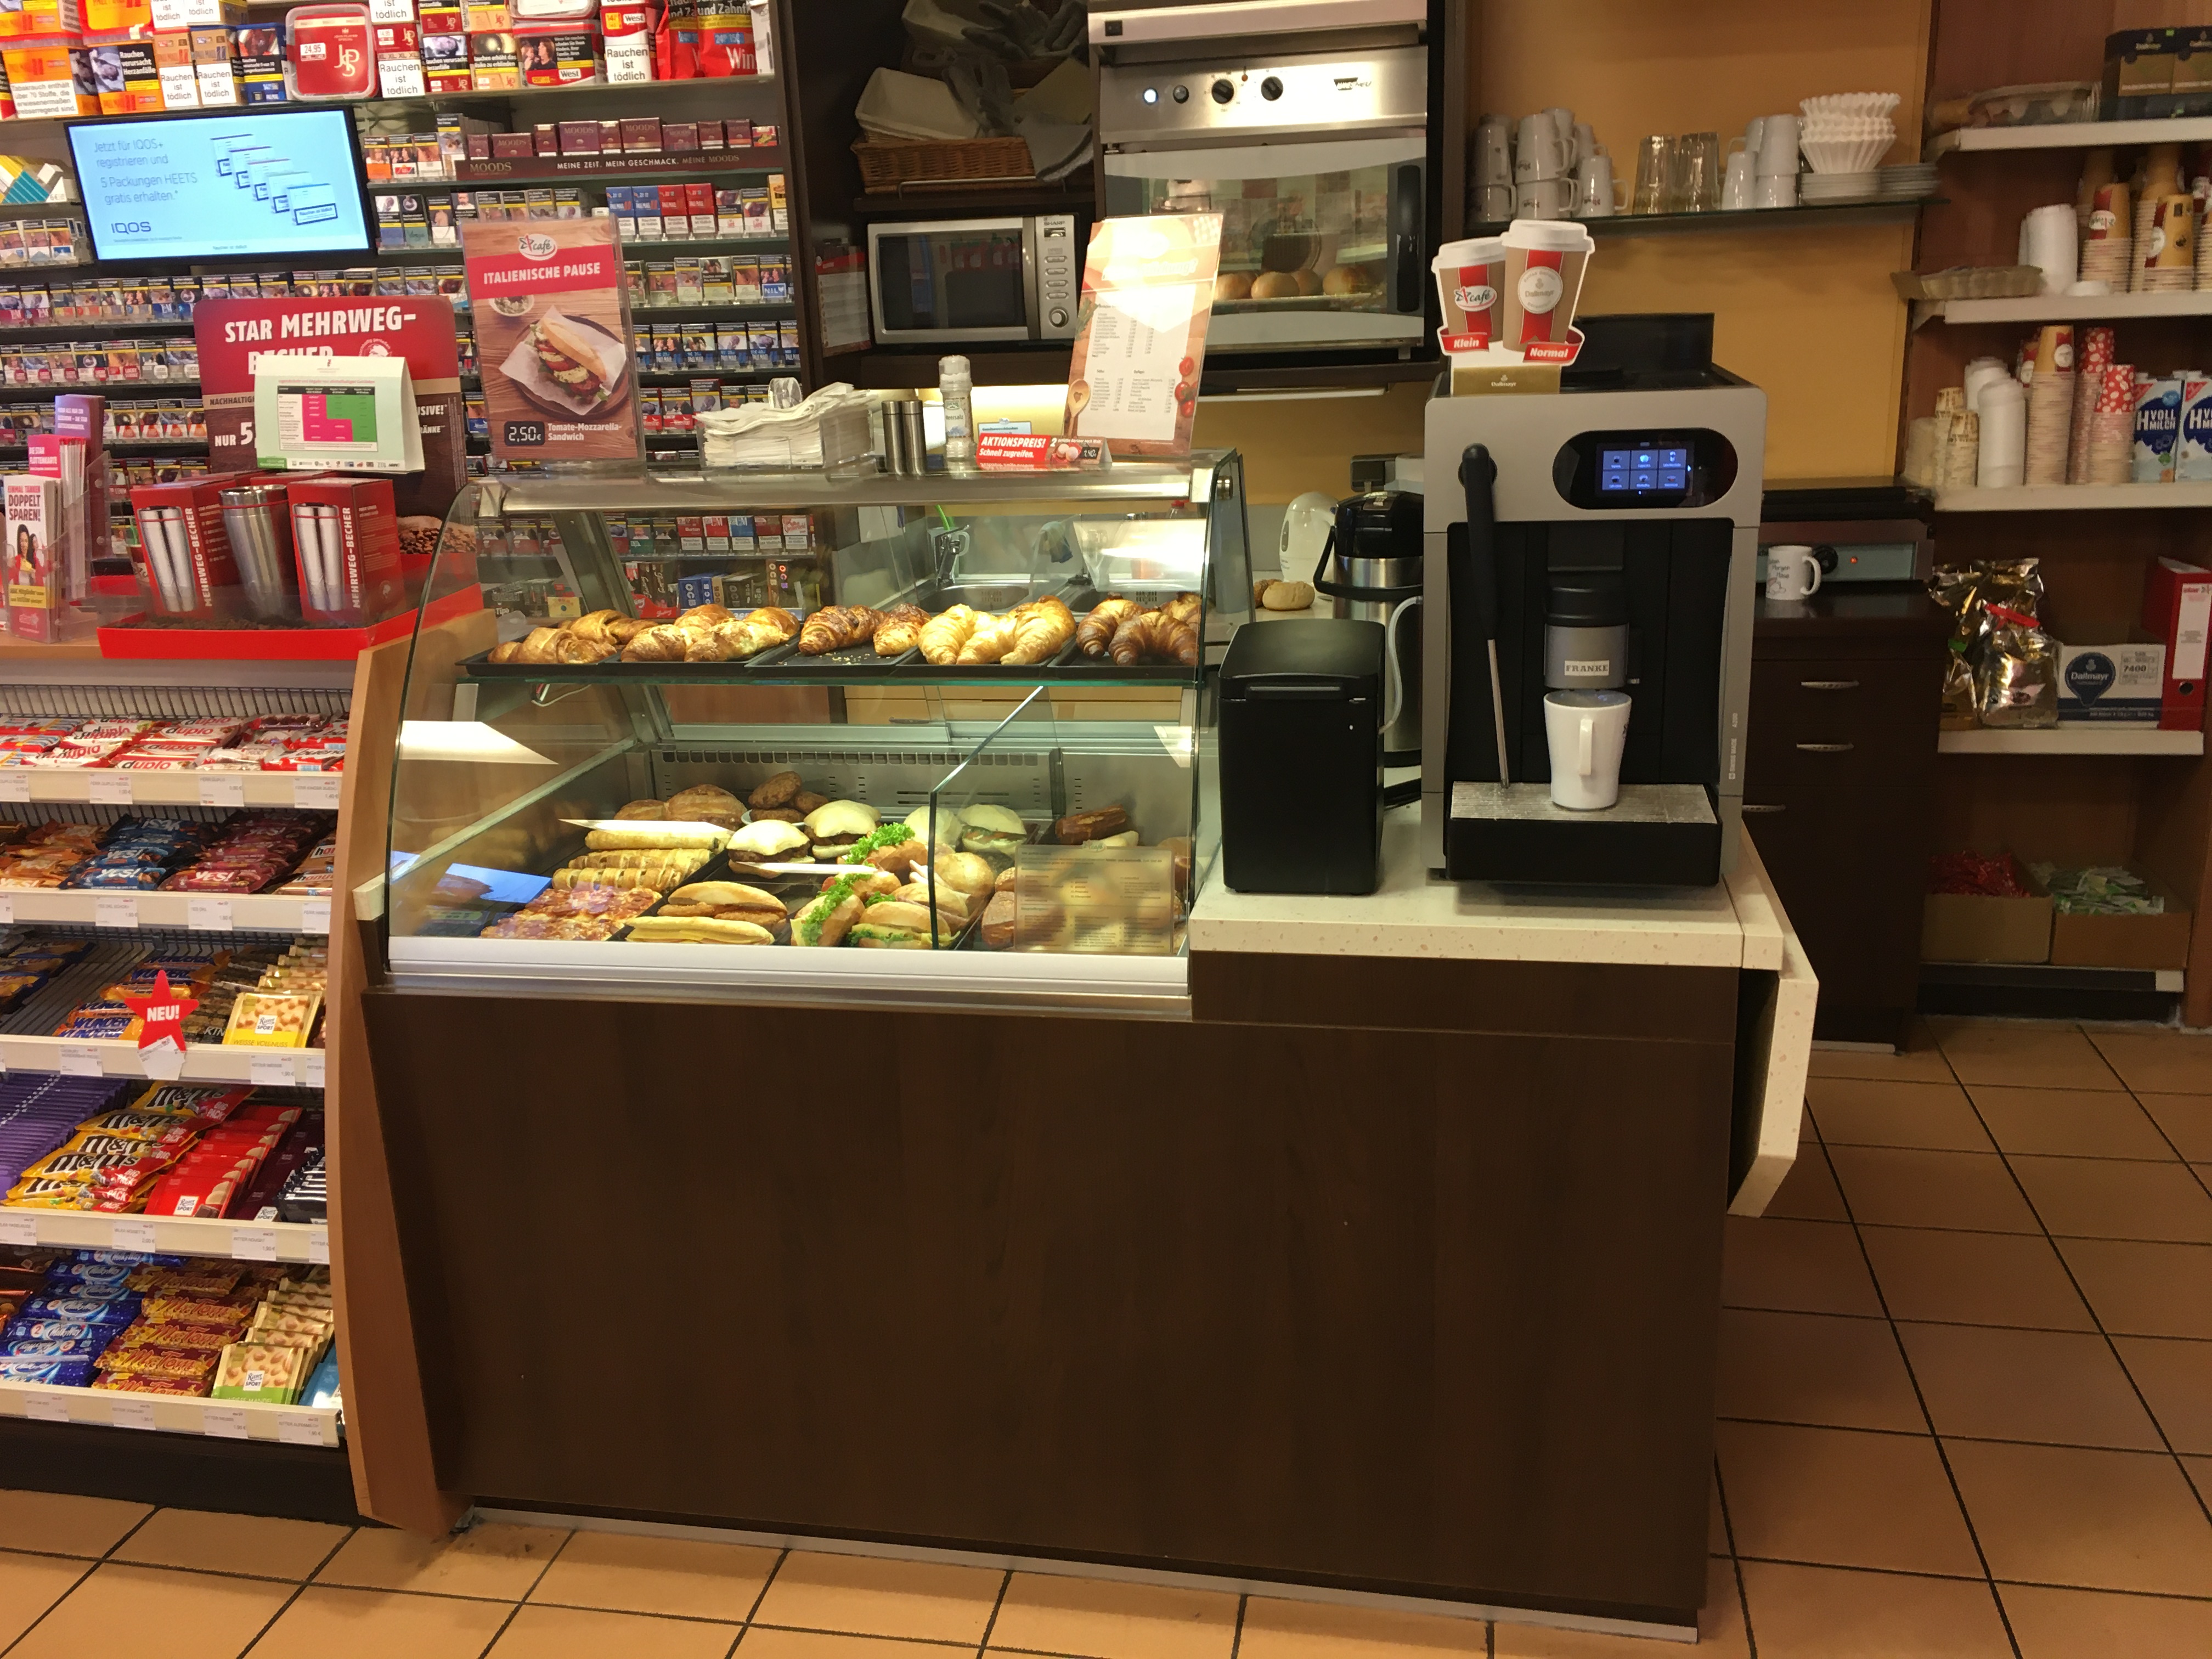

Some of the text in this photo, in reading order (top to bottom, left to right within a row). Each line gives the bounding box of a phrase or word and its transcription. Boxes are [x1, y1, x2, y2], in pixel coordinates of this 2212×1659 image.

[698, 6, 716, 15] und
[156, 12, 180, 21] tödlich
[607, 48, 647, 58] Rauchen
[380, 64, 420, 72] Rauchen
[623, 59, 634, 69] ist
[161, 74, 193, 82] Rauchen
[198, 71, 230, 80] Rauchen
[613, 71, 645, 81] tödlich
[205, 89, 229, 98] tödlich
[387, 86, 418, 95] tödlich
[167, 92, 191, 100] tödlich
[625, 124, 656, 132] MOODS
[94, 138, 164, 153] Jetzt für IQOS+
[95, 154, 168, 169] registrieren und
[557, 154, 740, 170] MEINE ZEIT. MEIN GESCHMACK. MEINE MOODS
[470, 162, 512, 173] MOODS
[101, 173, 198, 189] 5 Packungen HEETS
[105, 193, 131, 206] gratis
[111, 222, 151, 235] IQOS
[533, 240, 552, 255] café
[484, 262, 600, 284] ITALIENISCHE PAUSE
[764, 286, 779, 295] NIL
[1525, 289, 1555, 298] Dallmayr
[1470, 290, 1491, 304] café
[225, 306, 416, 343] STAR MEHRWEG-
[1454, 337, 1480, 348] Klein
[1530, 347, 1569, 358] Normal
[2137, 409, 2174, 431] H VOLL
[2149, 417, 2176, 430] MILCH
[548, 423, 622, 432] Tomate-Mozzarella-
[215, 435, 236, 447] NUR
[548, 432, 584, 441] Sandwich
[981, 436, 1046, 448] AKTIONSPREIS!
[1050, 438, 1057, 447] 2
[1003, 449, 1034, 458] zugreifen.
[8, 495, 41, 507] DOPPELT
[9, 508, 41, 521] SPAREN!
[185, 507, 213, 607] MEHRWEG-BECHER
[342, 507, 362, 608] MEHRWEG-BECHER
[686, 583, 696, 607] OCB
[1566, 663, 1609, 673] FRANKE
[2070, 672, 2110, 681] Dallmayr
[166, 725, 215, 738] duplo
[297, 748, 344, 757] bueno
[122, 760, 171, 770] duplo
[97, 868, 141, 879] YES!
[190, 871, 235, 882] YES!
[147, 1005, 179, 1022] NEU!
[214, 1102, 228, 1110] BIG
[207, 1109, 226, 1120] PACK
[162, 1134, 182, 1143] PACK
[125, 1169, 140, 1178] BIG
[117, 1176, 134, 1186] PACK
[108, 1190, 127, 1201] PACK
[34, 1327, 41, 1337] 2
[247, 1373, 262, 1382] Ritter
